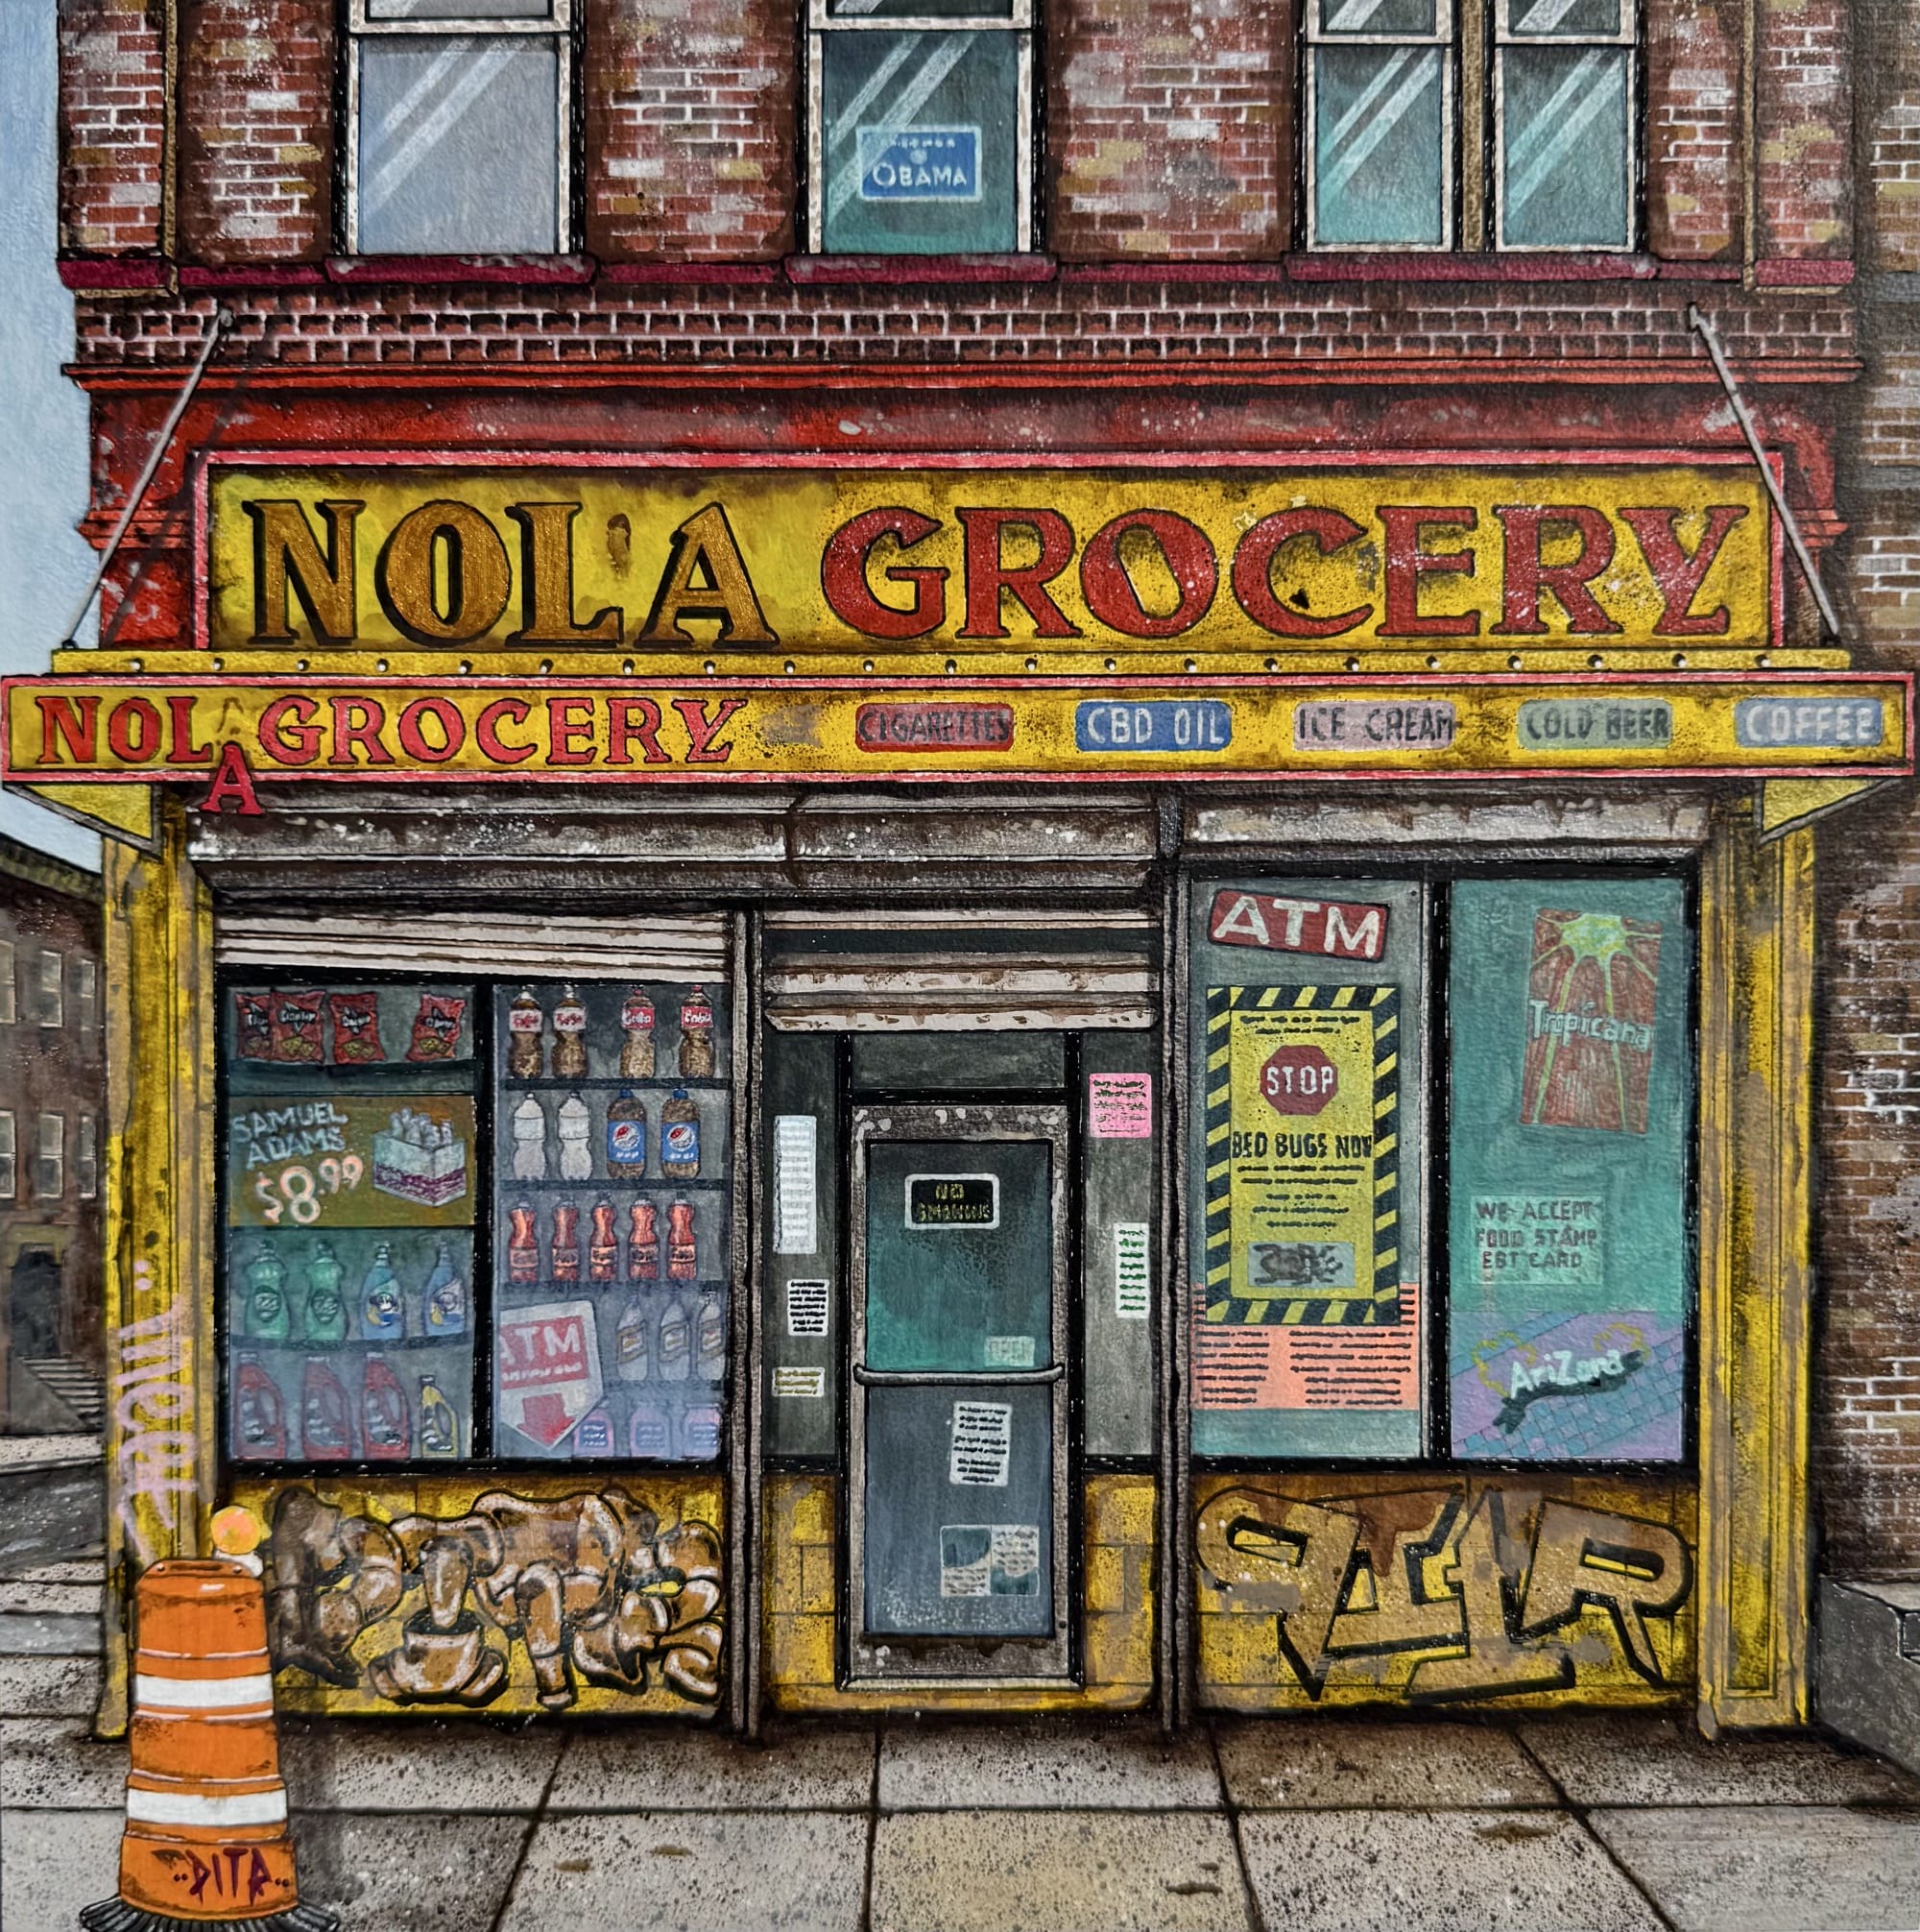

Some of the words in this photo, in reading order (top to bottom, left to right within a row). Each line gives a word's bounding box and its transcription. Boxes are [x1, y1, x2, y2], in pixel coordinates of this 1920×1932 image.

[872, 162, 967, 187] OBAMA
[246, 498, 780, 649] NOLA
[820, 504, 1750, 642] GROCERY
[257, 693, 750, 765] GROCERY
[859, 709, 1011, 743] CIGARETTES
[1087, 707, 1152, 744] CBD
[1174, 708, 1225, 745] OIL
[1299, 707, 1346, 741] ICE
[1364, 707, 1453, 743] CREAM
[1525, 708, 1595, 740] COLD
[1606, 708, 1670, 741] BEER
[1745, 705, 1874, 741] COFFEE
[1213, 896, 1380, 958] ATM
[1266, 1066, 1333, 1096] STOP
[230, 1102, 349, 1143] SAMUEL
[246, 1126, 348, 1171] ADAMS
[1232, 1130, 1268, 1159] BED
[1275, 1132, 1328, 1159] BUGS
[254, 1154, 364, 1224] $8.99
